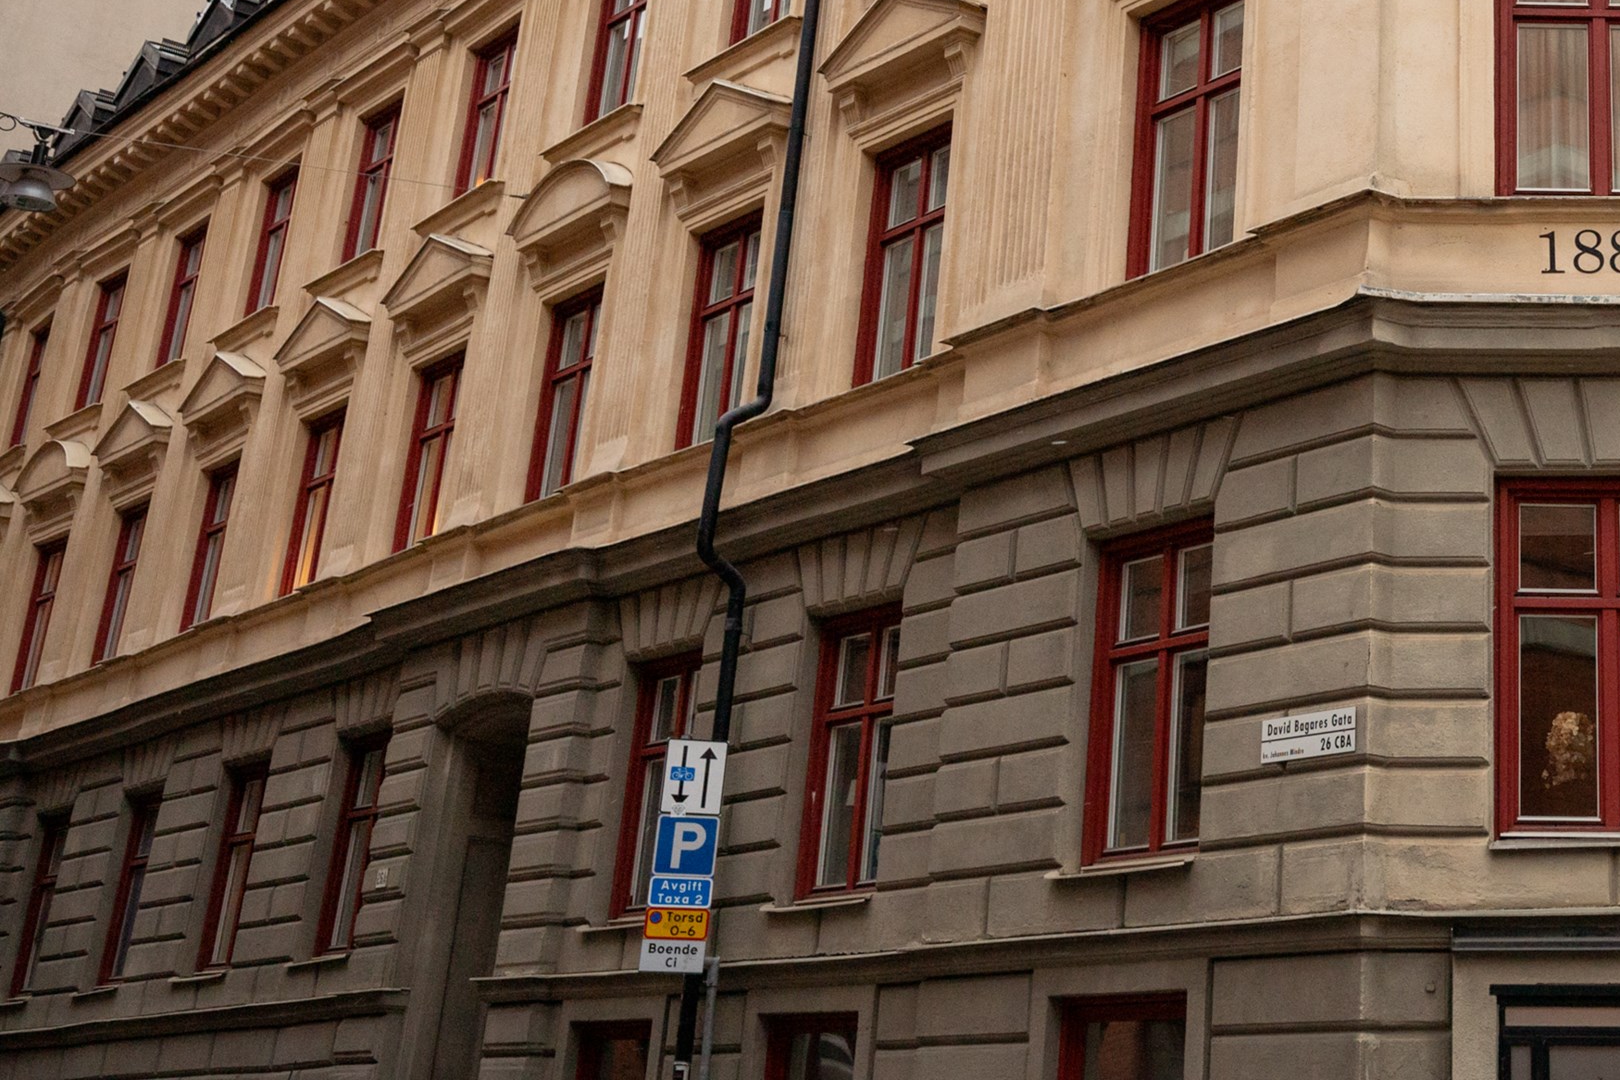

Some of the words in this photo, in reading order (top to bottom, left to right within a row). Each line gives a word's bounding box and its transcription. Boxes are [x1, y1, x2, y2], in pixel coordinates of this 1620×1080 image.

[1267, 720, 1291, 736] David
[1294, 718, 1328, 735] Bagares
[1331, 713, 1352, 726] Gata
[1320, 736, 1331, 751] 26
[1334, 734, 1352, 749] CBA
[669, 821, 707, 869] P
[661, 880, 703, 893] Avgift
[657, 893, 690, 904] Taxa
[694, 894, 703, 904] 2
[667, 911, 704, 923] Torsd
[648, 943, 699, 955] Boende
[665, 957, 677, 968] Ci
